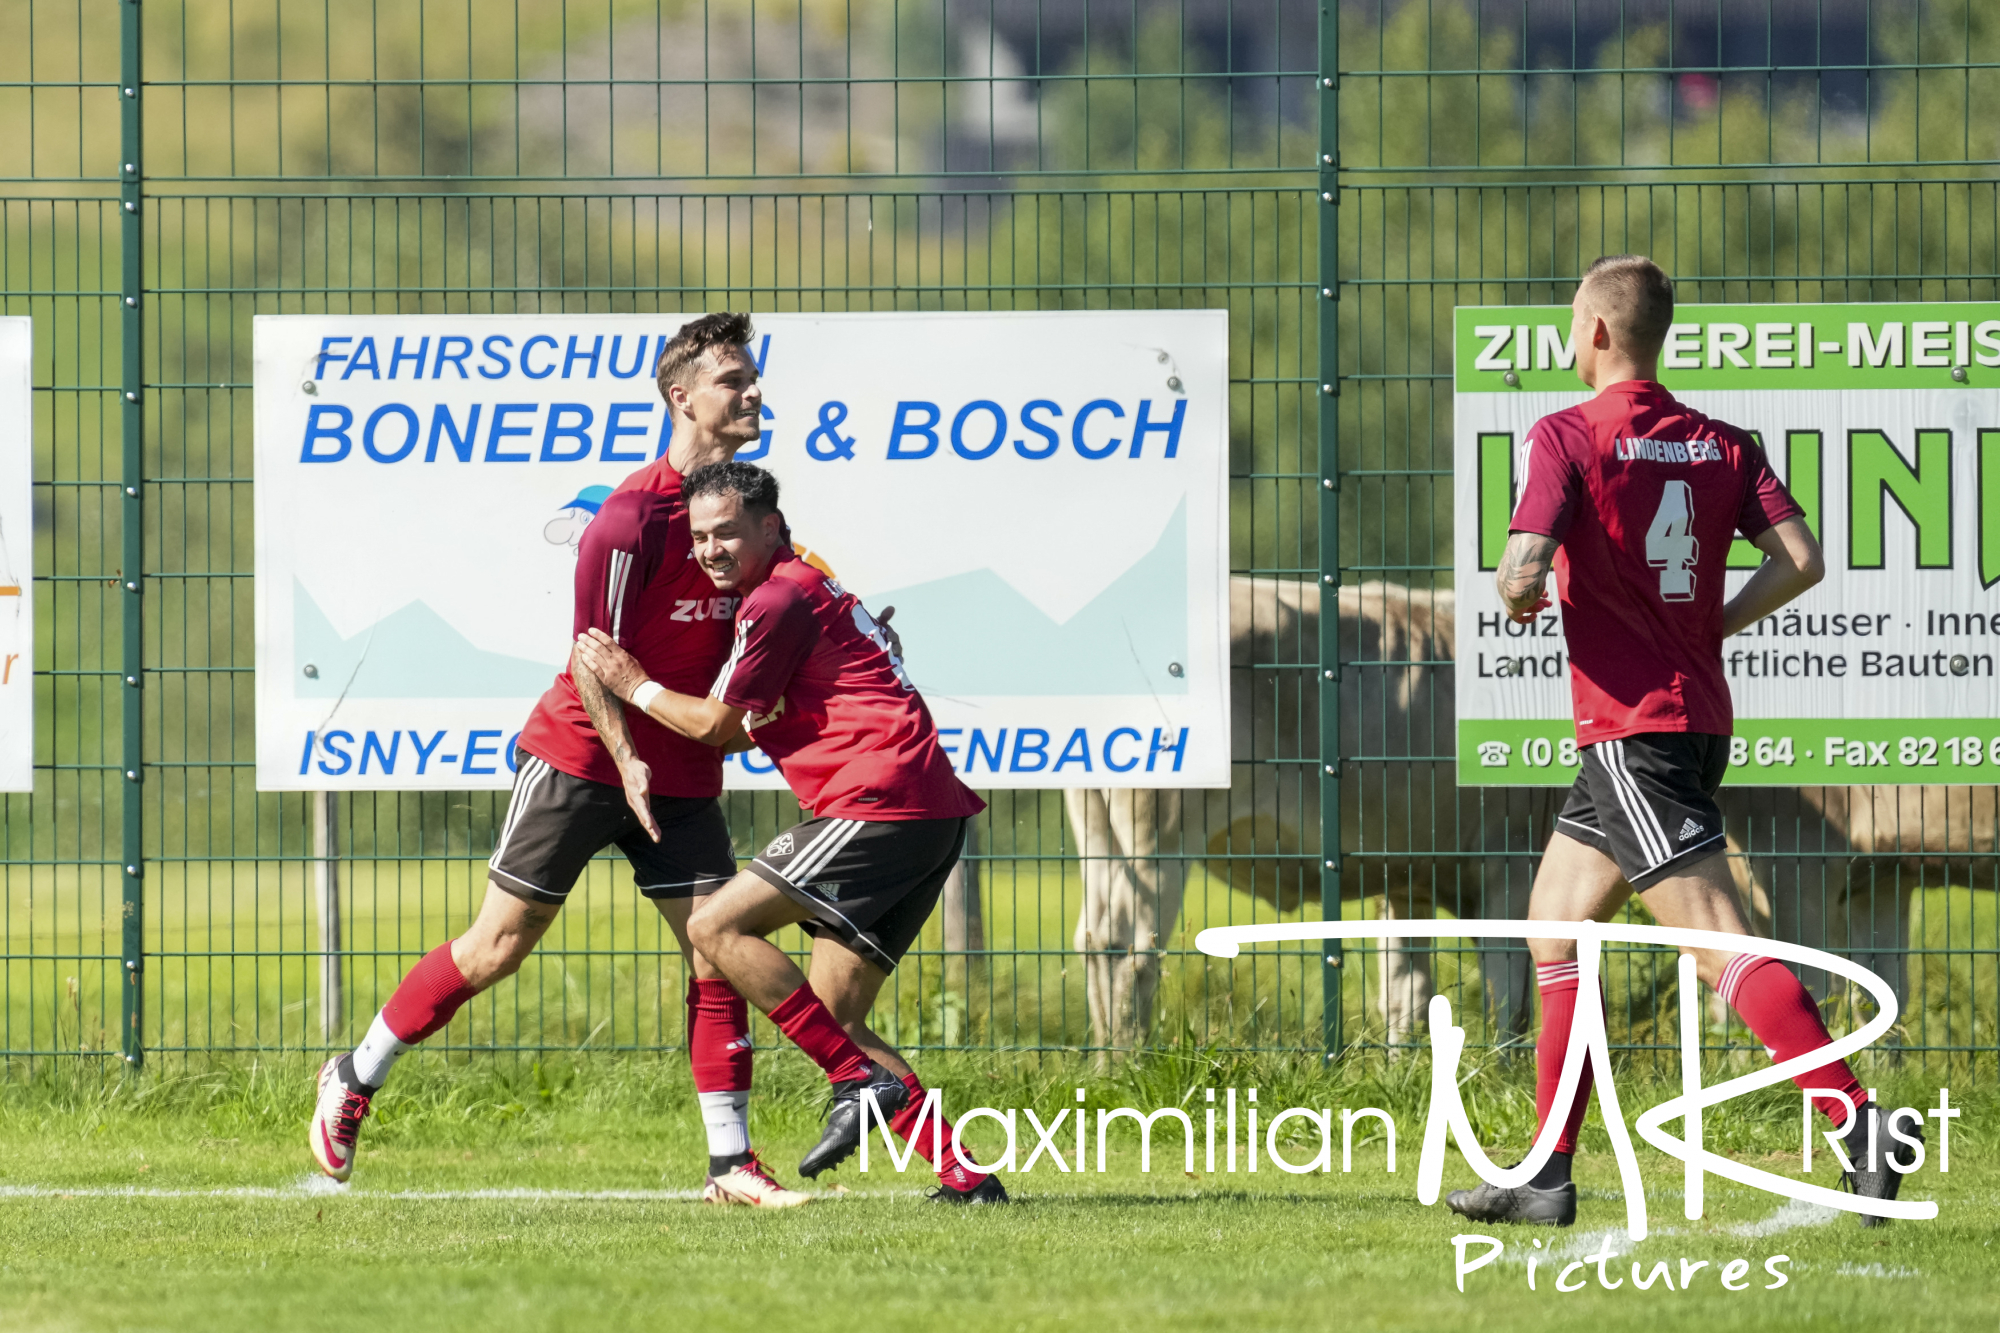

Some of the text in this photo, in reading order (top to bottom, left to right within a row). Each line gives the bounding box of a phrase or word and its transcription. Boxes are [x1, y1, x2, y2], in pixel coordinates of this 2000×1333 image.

[1474, 320, 2000, 371] ZIMEREI-MEIS
[299, 398, 1188, 463] BONEBEG & BOSCH
[1615, 437, 1722, 463] LINDENBERG
[1645, 480, 1699, 602] 4
[1825, 736, 1891, 767] Fax
[1679, 825, 1704, 841] adidas
